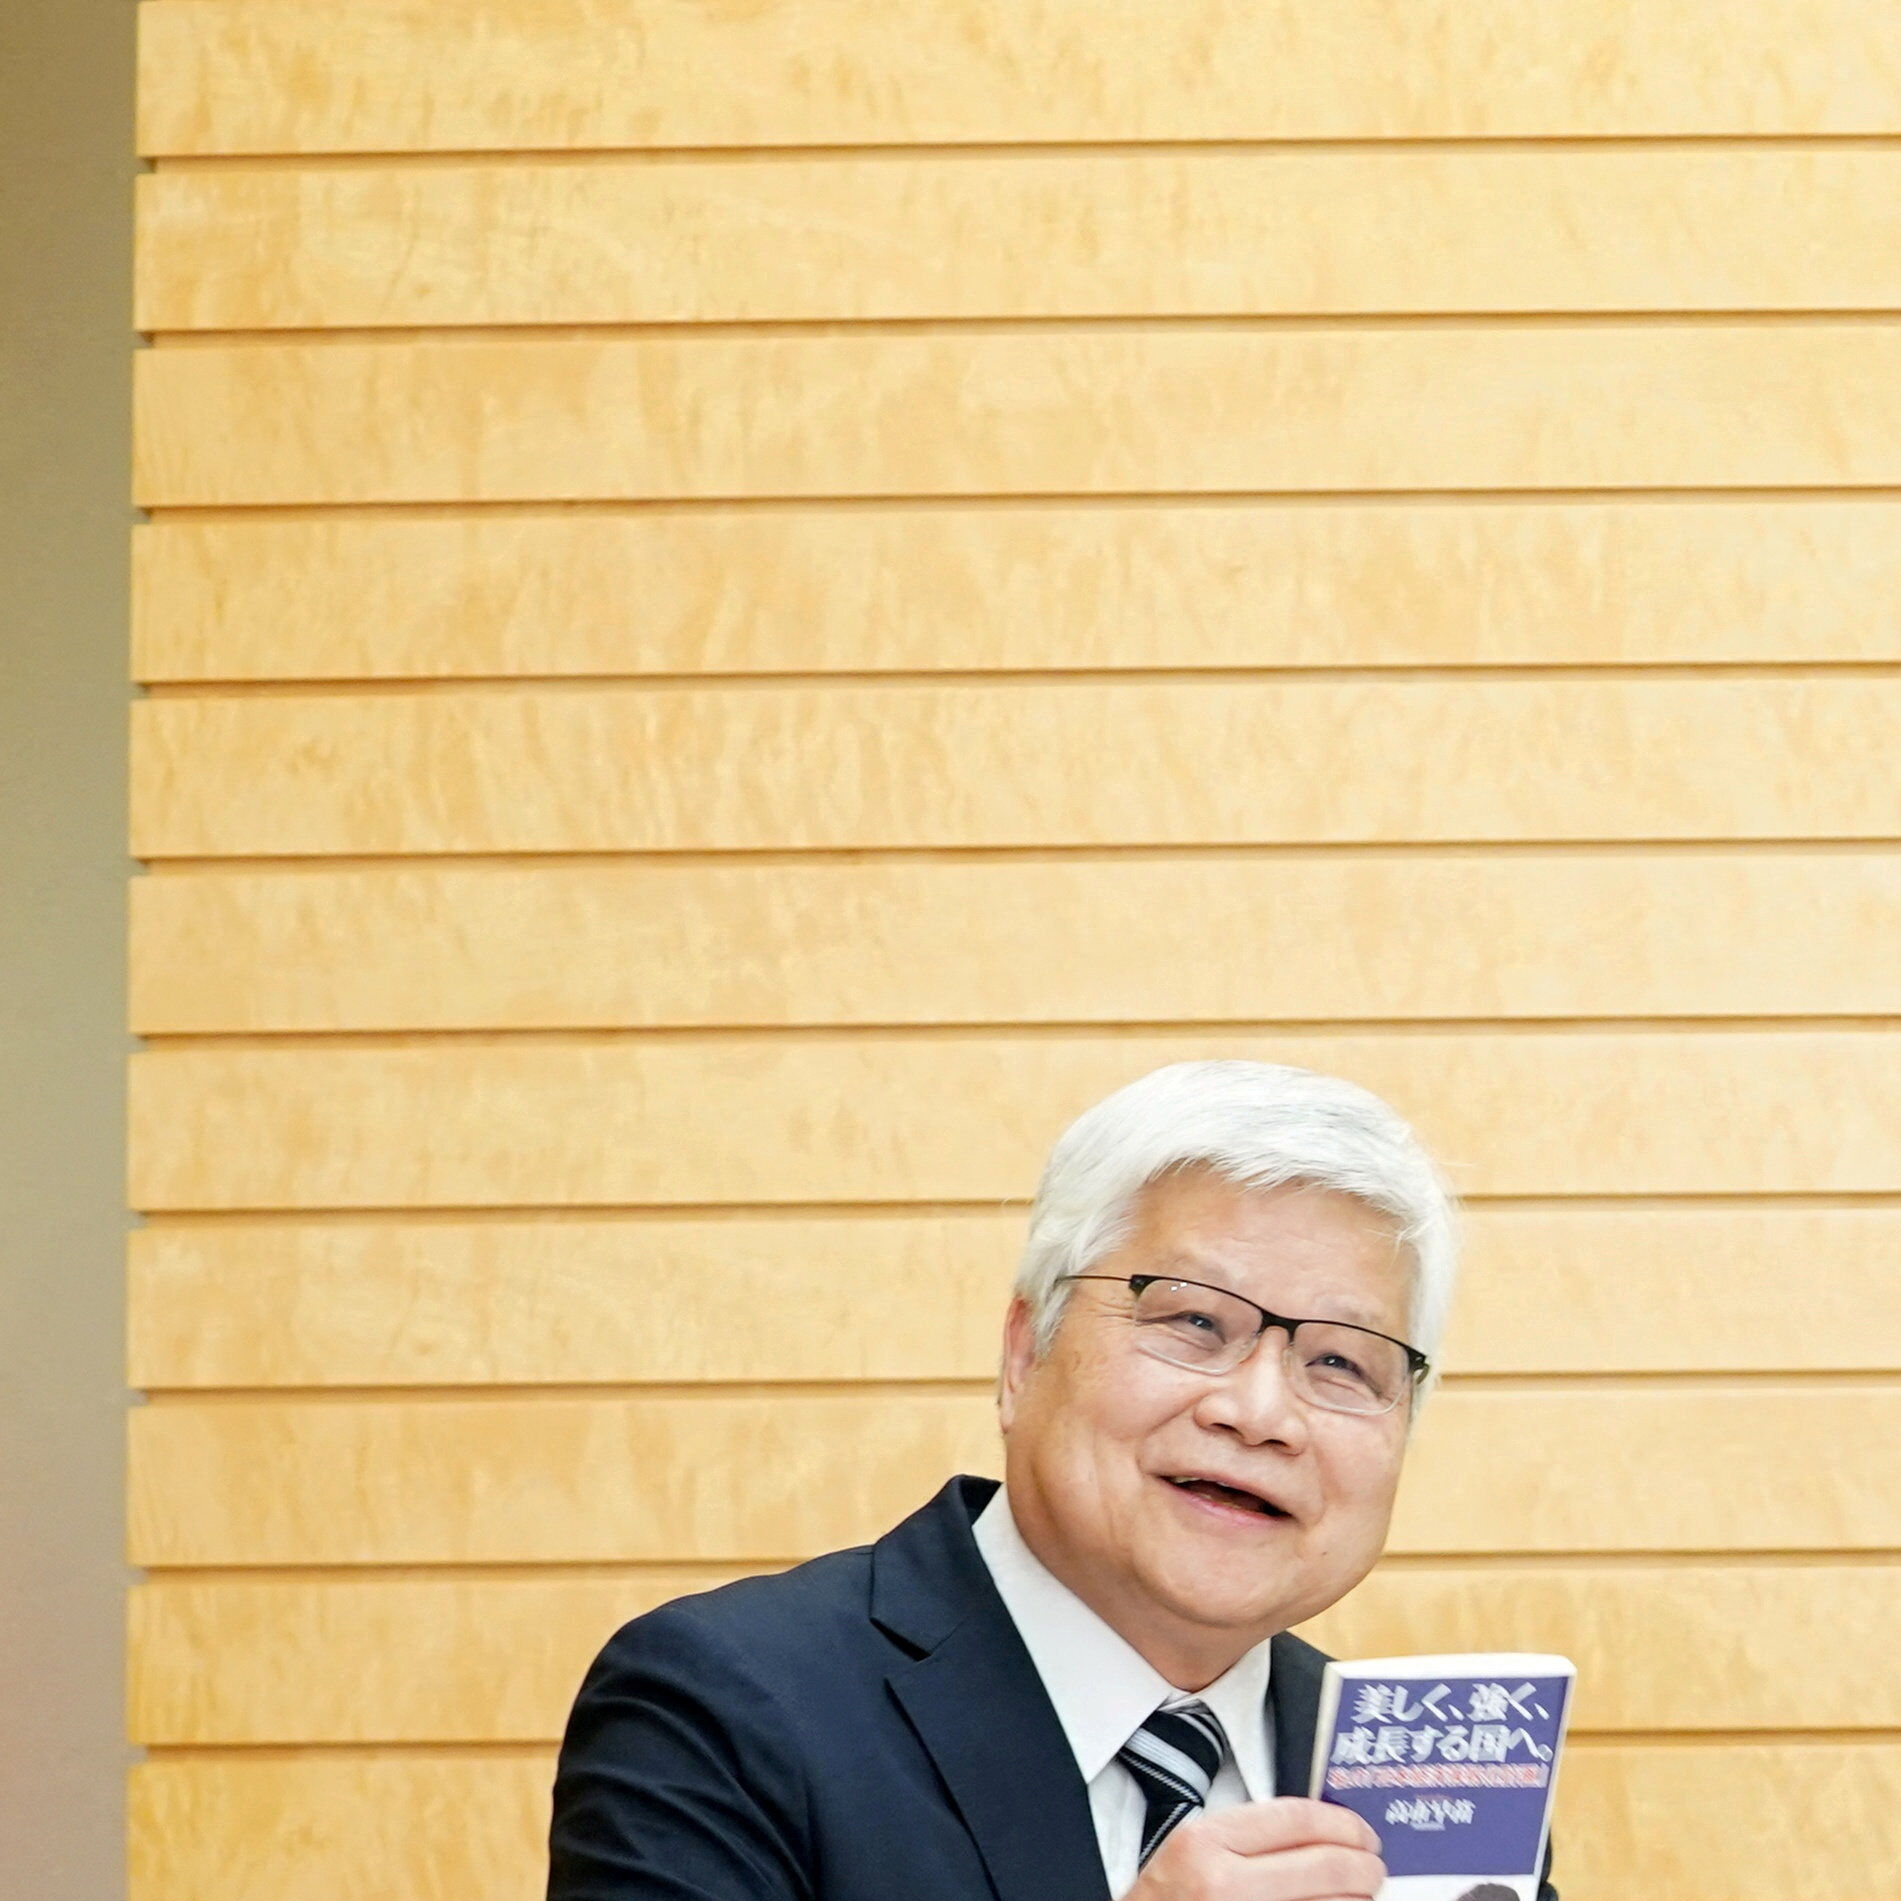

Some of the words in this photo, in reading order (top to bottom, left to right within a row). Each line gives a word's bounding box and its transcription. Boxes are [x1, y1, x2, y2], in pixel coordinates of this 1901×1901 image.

[1351, 1682, 1549, 1723] 美しく、強く、
[1330, 1724, 1553, 1765] 成長する国へ。
